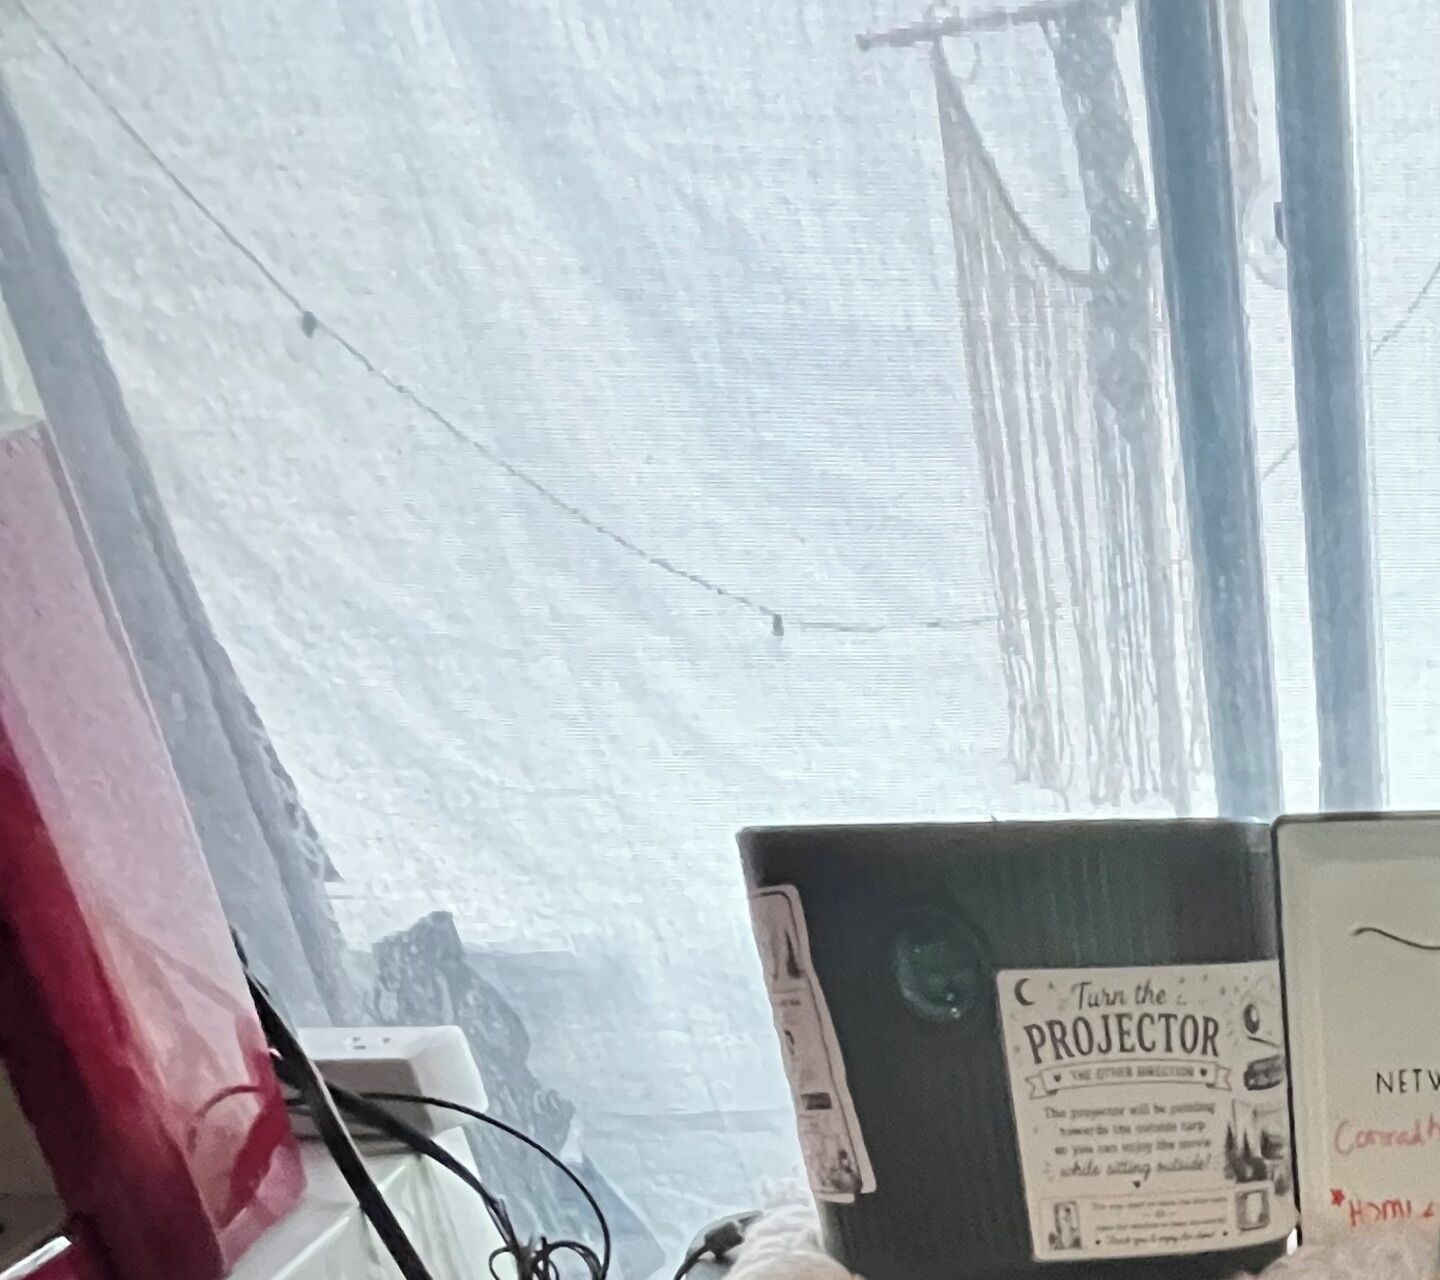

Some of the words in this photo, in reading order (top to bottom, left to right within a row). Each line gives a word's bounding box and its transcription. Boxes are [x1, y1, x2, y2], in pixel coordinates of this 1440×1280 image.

[1072, 981, 1126, 1010] Turn
[1134, 979, 1166, 1005] the
[1023, 1012, 1219, 1065] PROJECTOR
